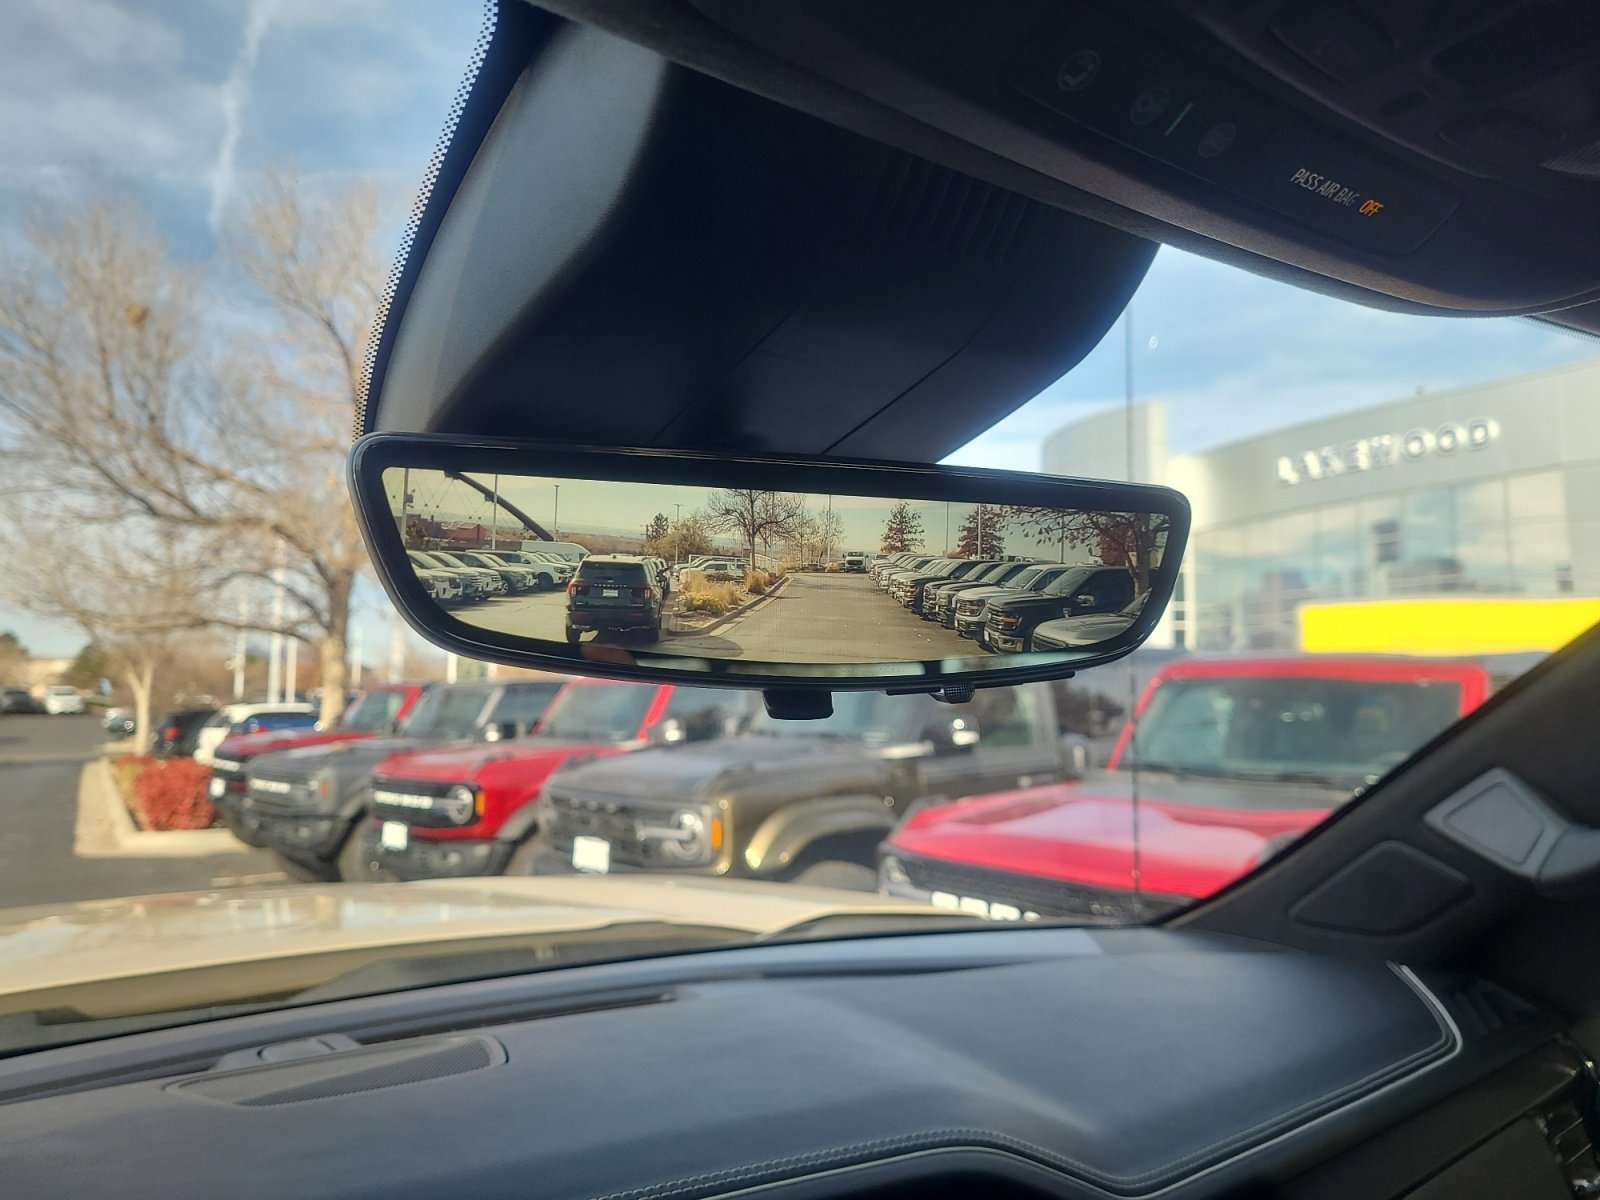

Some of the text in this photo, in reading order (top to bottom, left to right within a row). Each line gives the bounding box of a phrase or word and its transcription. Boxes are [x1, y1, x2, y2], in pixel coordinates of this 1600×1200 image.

[1290, 168, 1384, 217] PASS AIR BAG OFF
